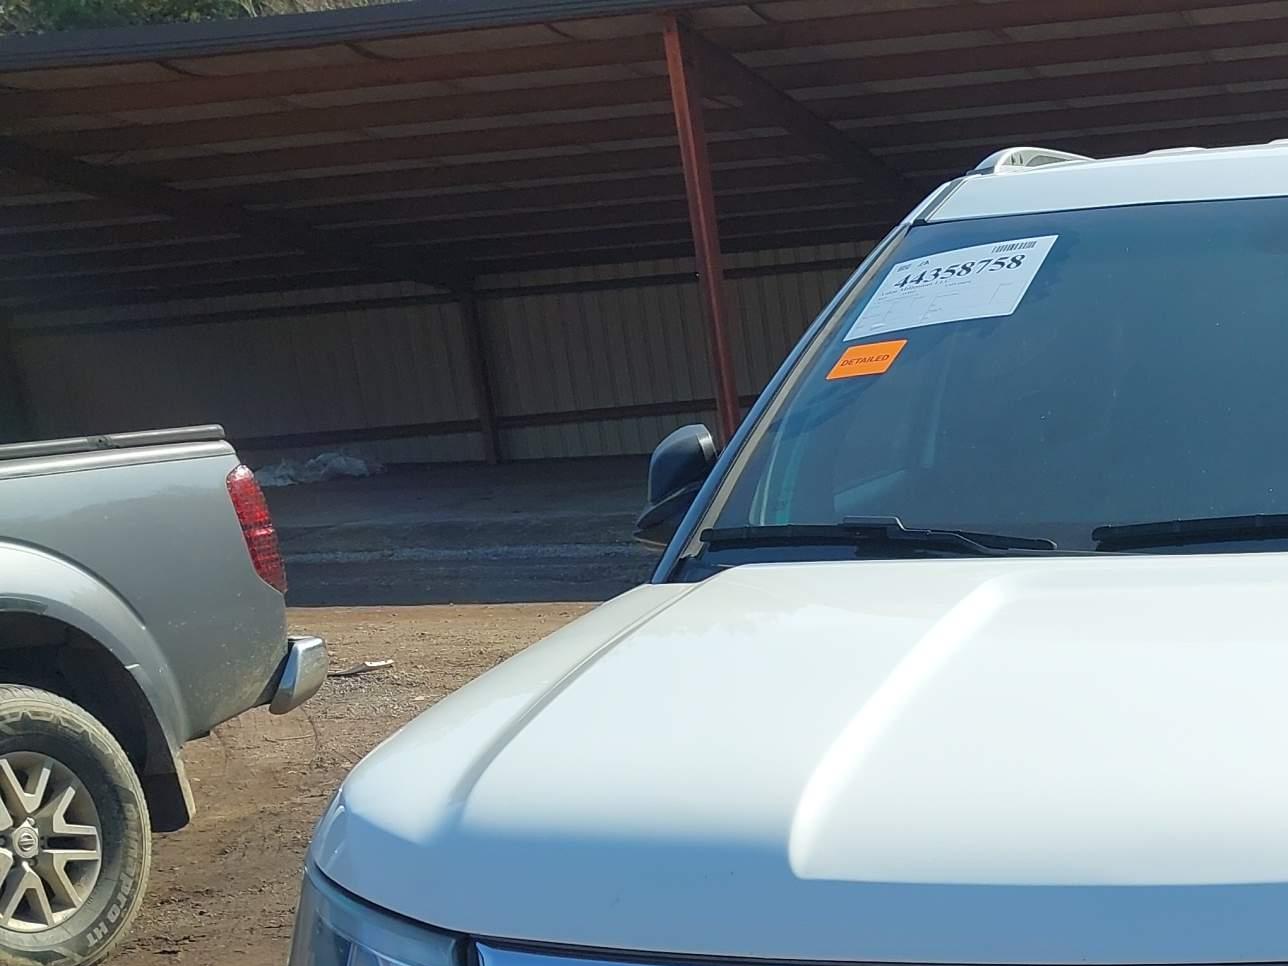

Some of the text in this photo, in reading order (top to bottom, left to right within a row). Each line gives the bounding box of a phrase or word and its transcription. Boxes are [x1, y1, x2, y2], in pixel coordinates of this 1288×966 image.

[894, 254, 1026, 290] 44358758
[840, 354, 890, 367] DETAILED
[86, 921, 109, 948] HT
